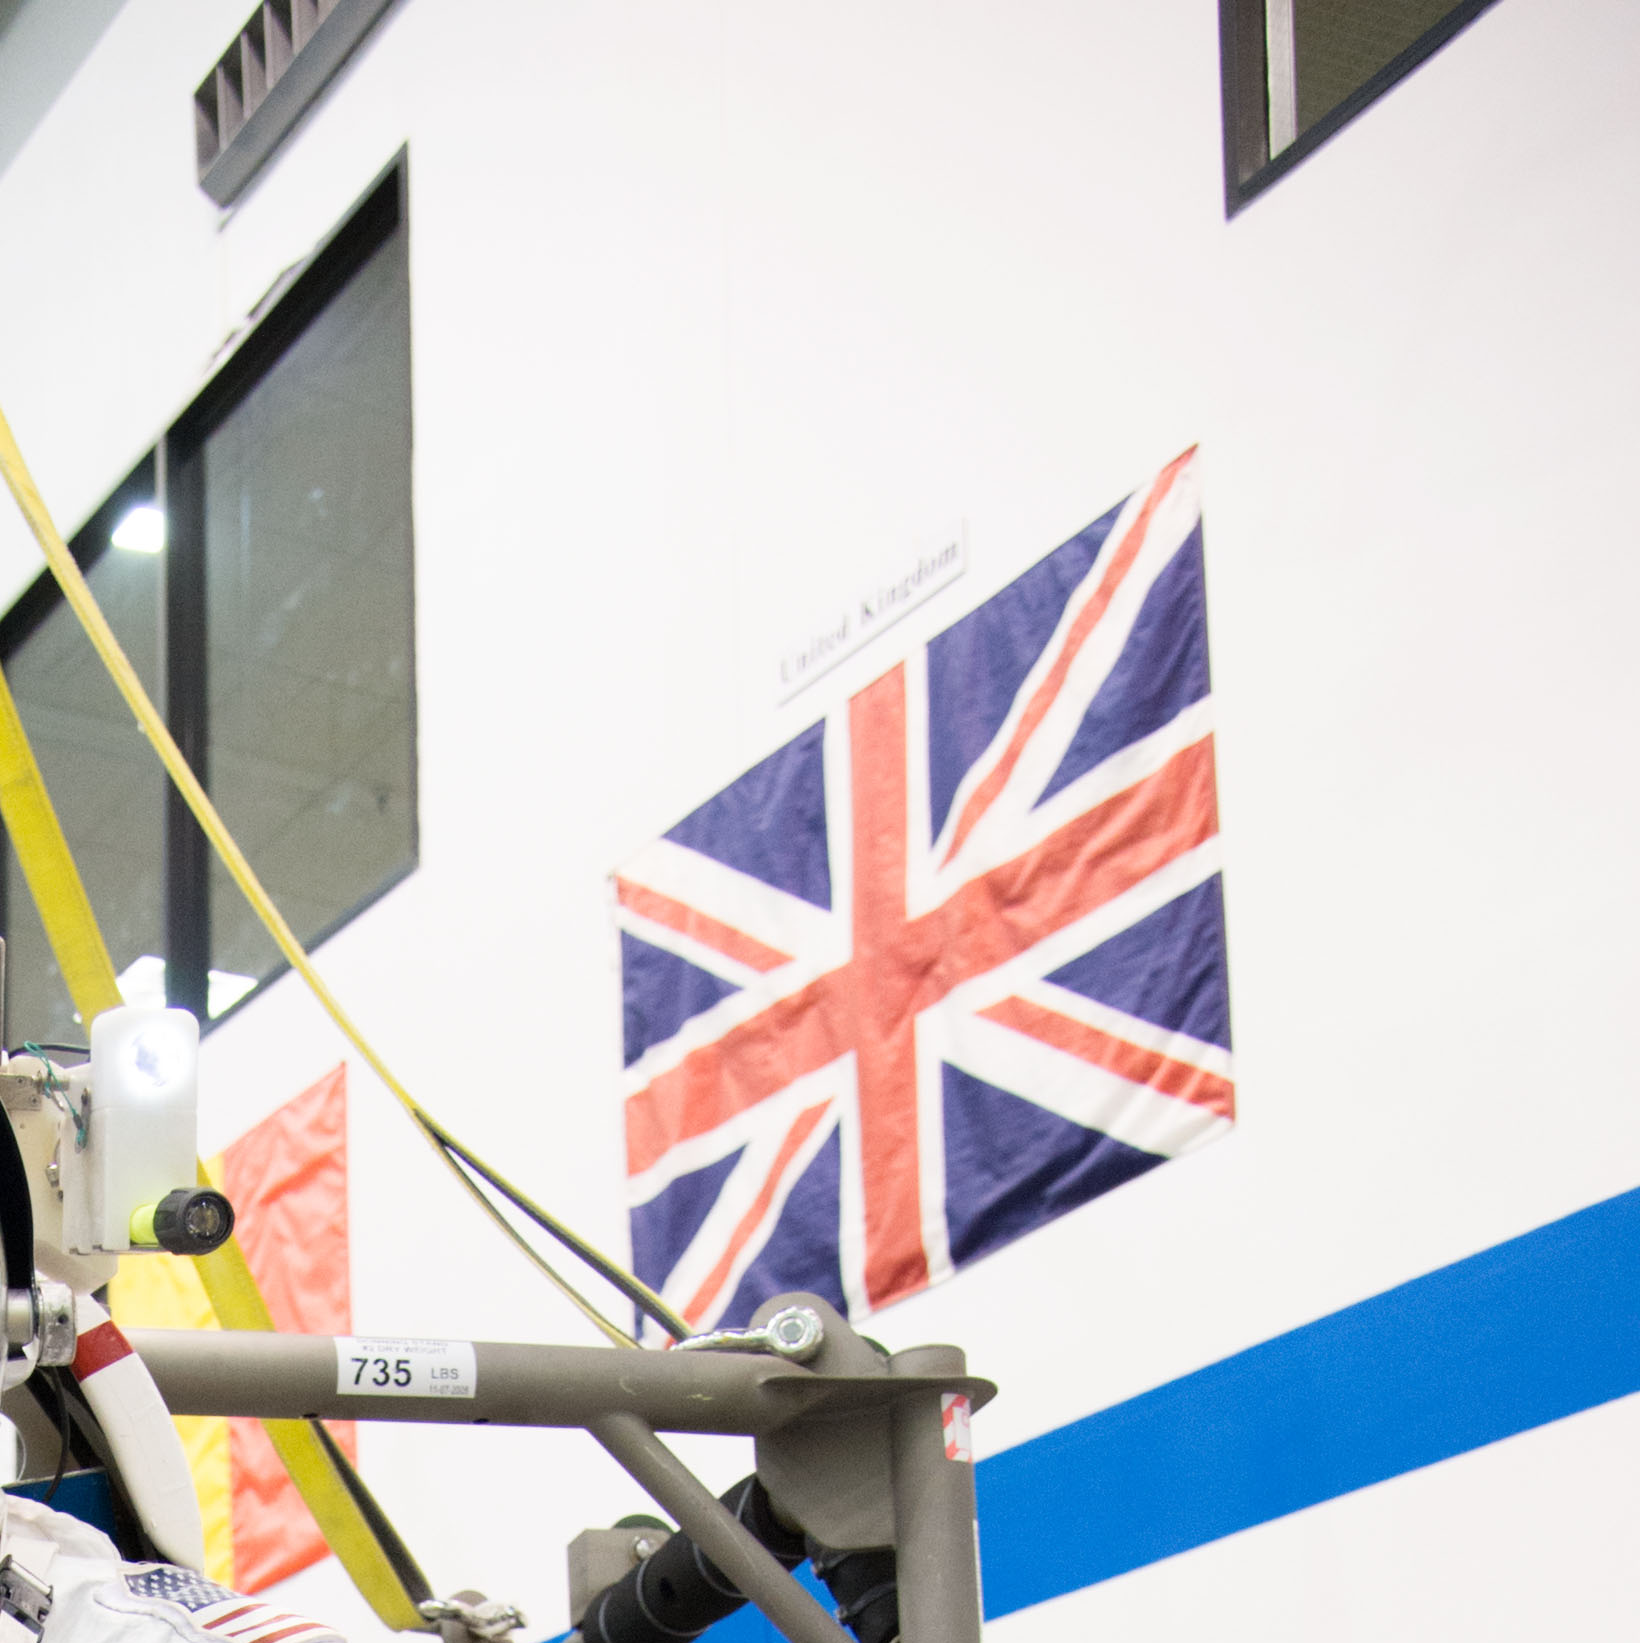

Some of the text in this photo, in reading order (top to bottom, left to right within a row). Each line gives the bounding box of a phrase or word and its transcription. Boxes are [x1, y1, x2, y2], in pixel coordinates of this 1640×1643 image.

[780, 541, 959, 684] United Kingdom
[351, 1357, 459, 1387] 735 LBS
